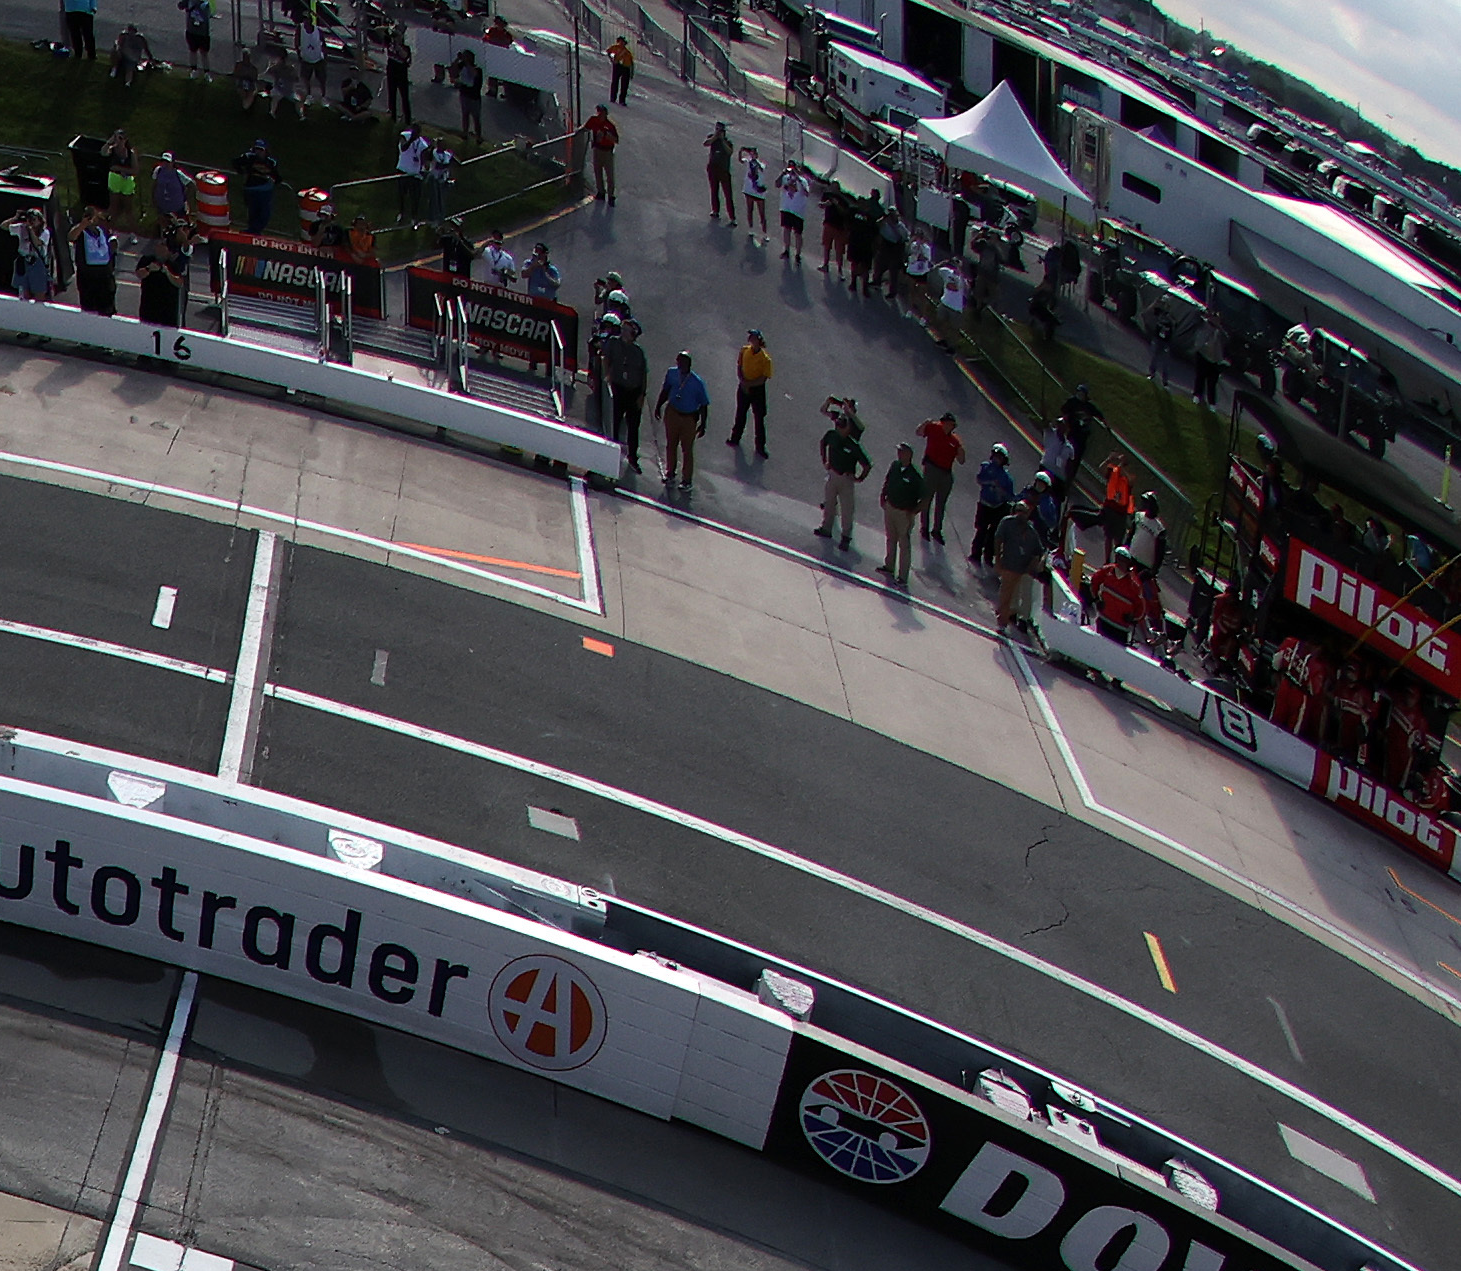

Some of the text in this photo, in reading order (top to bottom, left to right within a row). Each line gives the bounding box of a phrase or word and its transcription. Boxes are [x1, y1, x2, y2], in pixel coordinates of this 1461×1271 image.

[262, 261, 344, 294] NASCA
[461, 301, 552, 343] NASCAR
[150, 330, 192, 361] 16
[1219, 700, 1255, 748] 8
